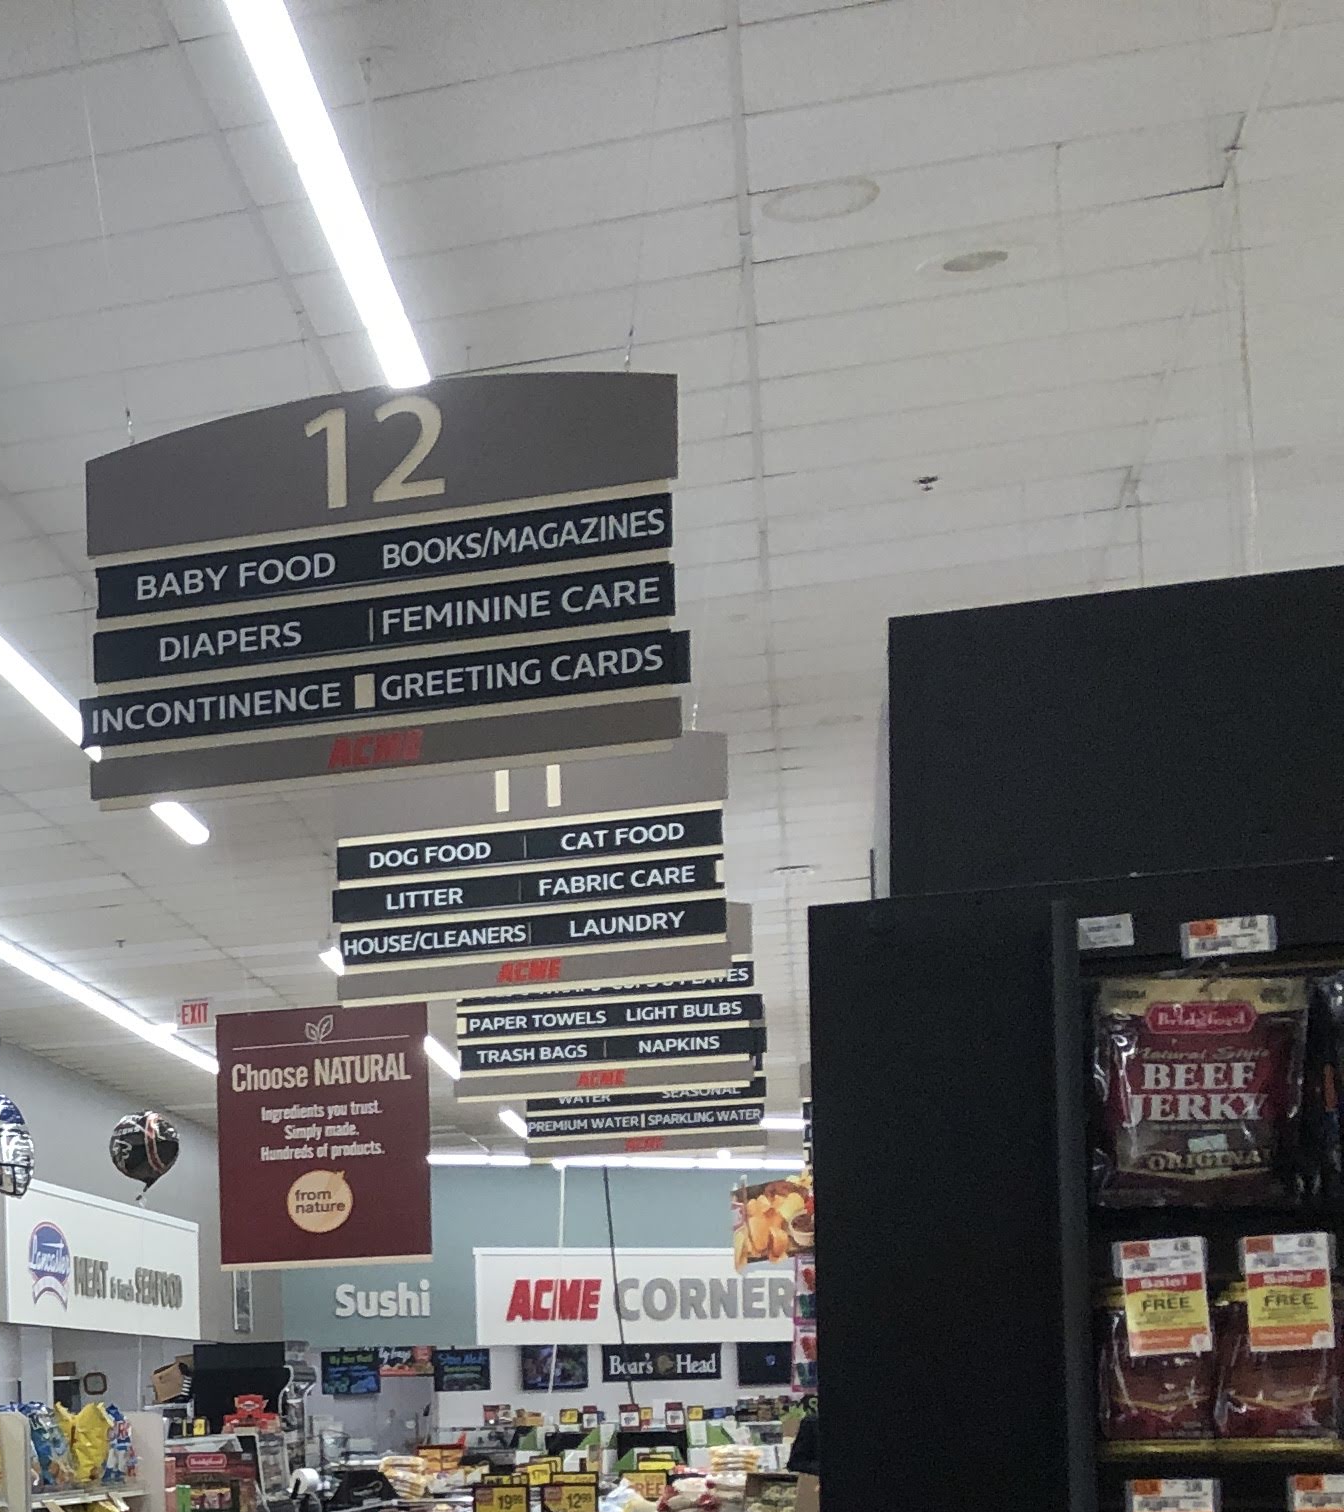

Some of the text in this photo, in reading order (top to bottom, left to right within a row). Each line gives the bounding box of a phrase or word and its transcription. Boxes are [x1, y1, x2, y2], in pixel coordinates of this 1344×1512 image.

[305, 395, 446, 510] 12
[382, 508, 665, 570] BOOKS/MAGAZINES
[136, 552, 336, 601] BABY FOOD
[382, 577, 661, 636] FEMININE CARE
[159, 621, 302, 664] DIAPERS
[380, 644, 664, 703] GREETING CARDS
[91, 682, 341, 735] INCONTINENCE
[327, 728, 424, 769] ACME
[560, 822, 685, 851] CAT FOOD
[368, 840, 492, 870] DOG FOOD
[538, 864, 696, 897] FABRIC CARE
[385, 887, 464, 911] LITTER
[568, 910, 686, 939] LAUNDRY
[343, 924, 527, 957] HOUSE/CLEANERS
[497, 958, 562, 983] ACME
[181, 1001, 209, 1025] EXIT
[469, 1009, 607, 1032] PAPER TOWELS
[625, 1001, 743, 1022] LIGHT BULBS
[476, 1043, 588, 1065] TRASH BAGS
[637, 1035, 720, 1054] NAPKINS
[231, 1052, 412, 1092] Choose NATURAL
[1141, 1062, 1256, 1090] BEEF
[261, 1099, 383, 1124] Ingredients you trust.
[527, 1114, 639, 1134] PREMIUM WATER
[647, 1107, 761, 1128] SPARKLING WATER
[1121, 1093, 1268, 1129] JERKY
[284, 1122, 360, 1141] Simply made.
[260, 1140, 386, 1162] Hundreds of products.
[295, 1189, 332, 1202] from
[295, 1201, 346, 1214] nature
[73, 1255, 108, 1299] MEAT
[134, 1266, 183, 1309] SEAFOOD
[334, 1278, 431, 1319] Sushi
[506, 1276, 794, 1322] ACME CORNER
[1141, 1296, 1191, 1312] FREE
[1263, 1292, 1315, 1308] FREE
[609, 1352, 717, 1376] Boar's Head
